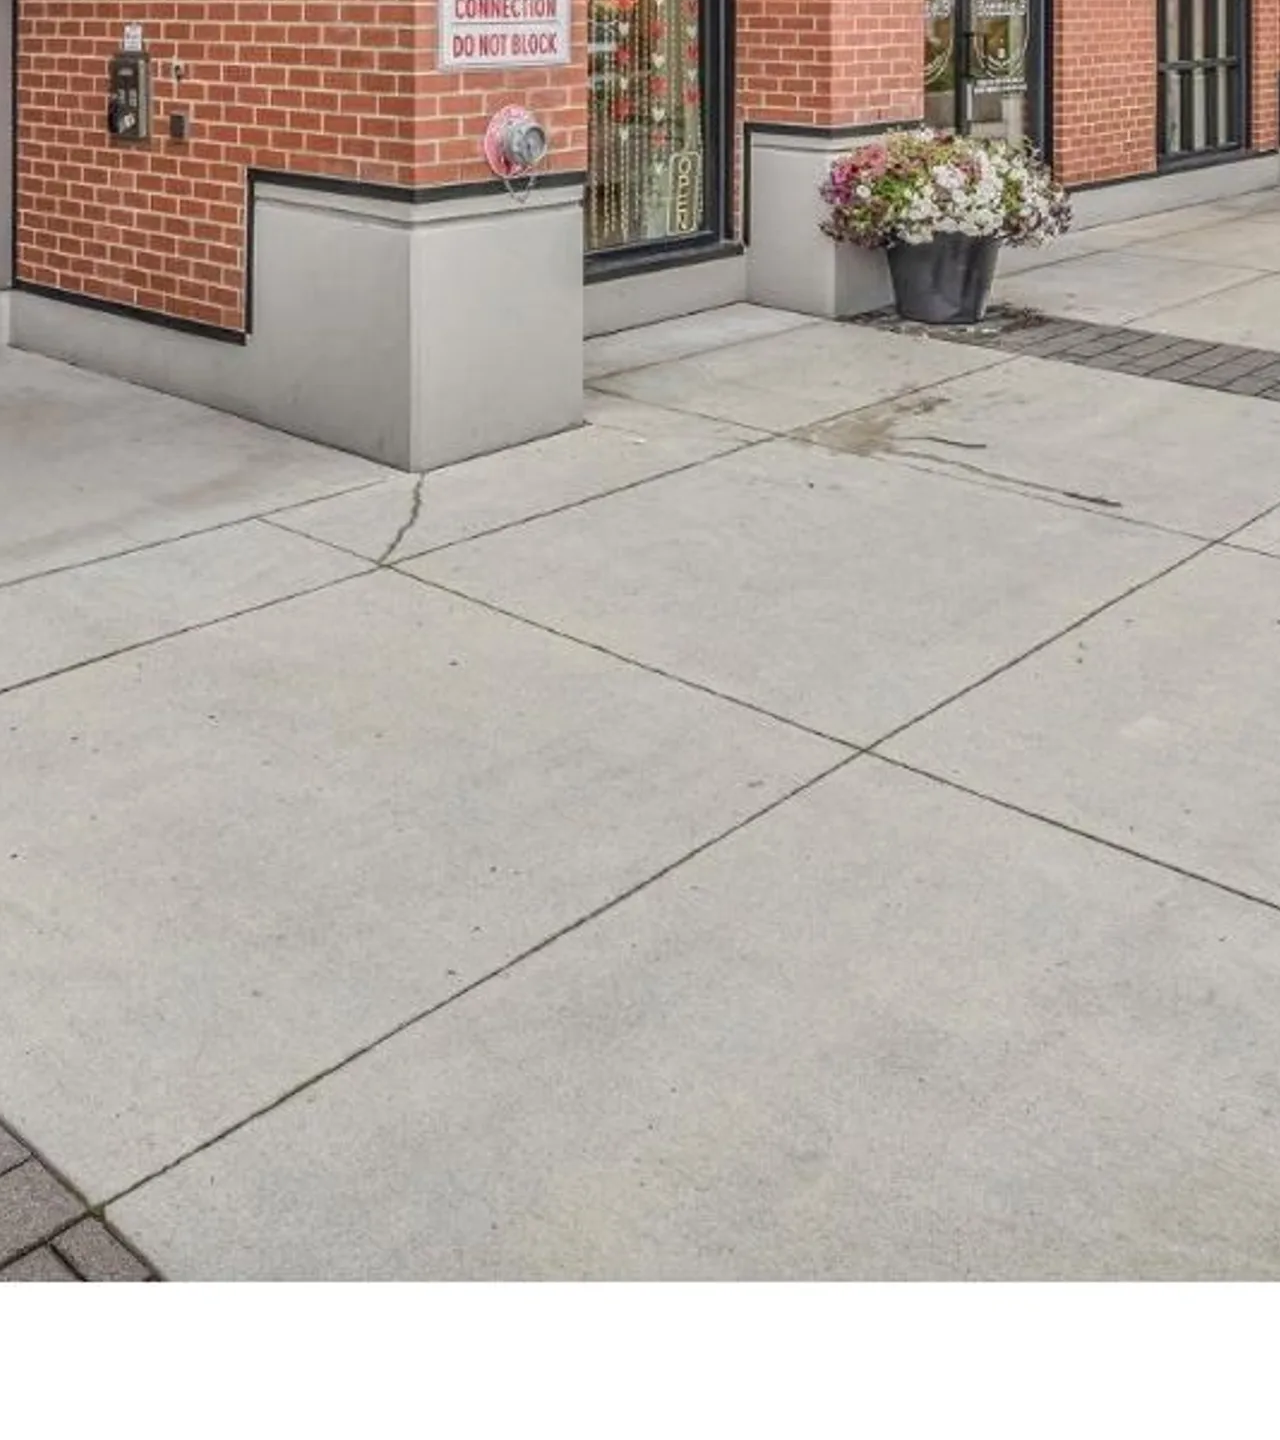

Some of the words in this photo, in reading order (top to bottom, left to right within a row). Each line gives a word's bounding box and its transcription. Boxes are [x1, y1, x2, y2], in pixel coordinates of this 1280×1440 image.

[453, 35, 475, 58] DO
[479, 34, 507, 56] NOT
[511, 32, 558, 55] BLOCK
